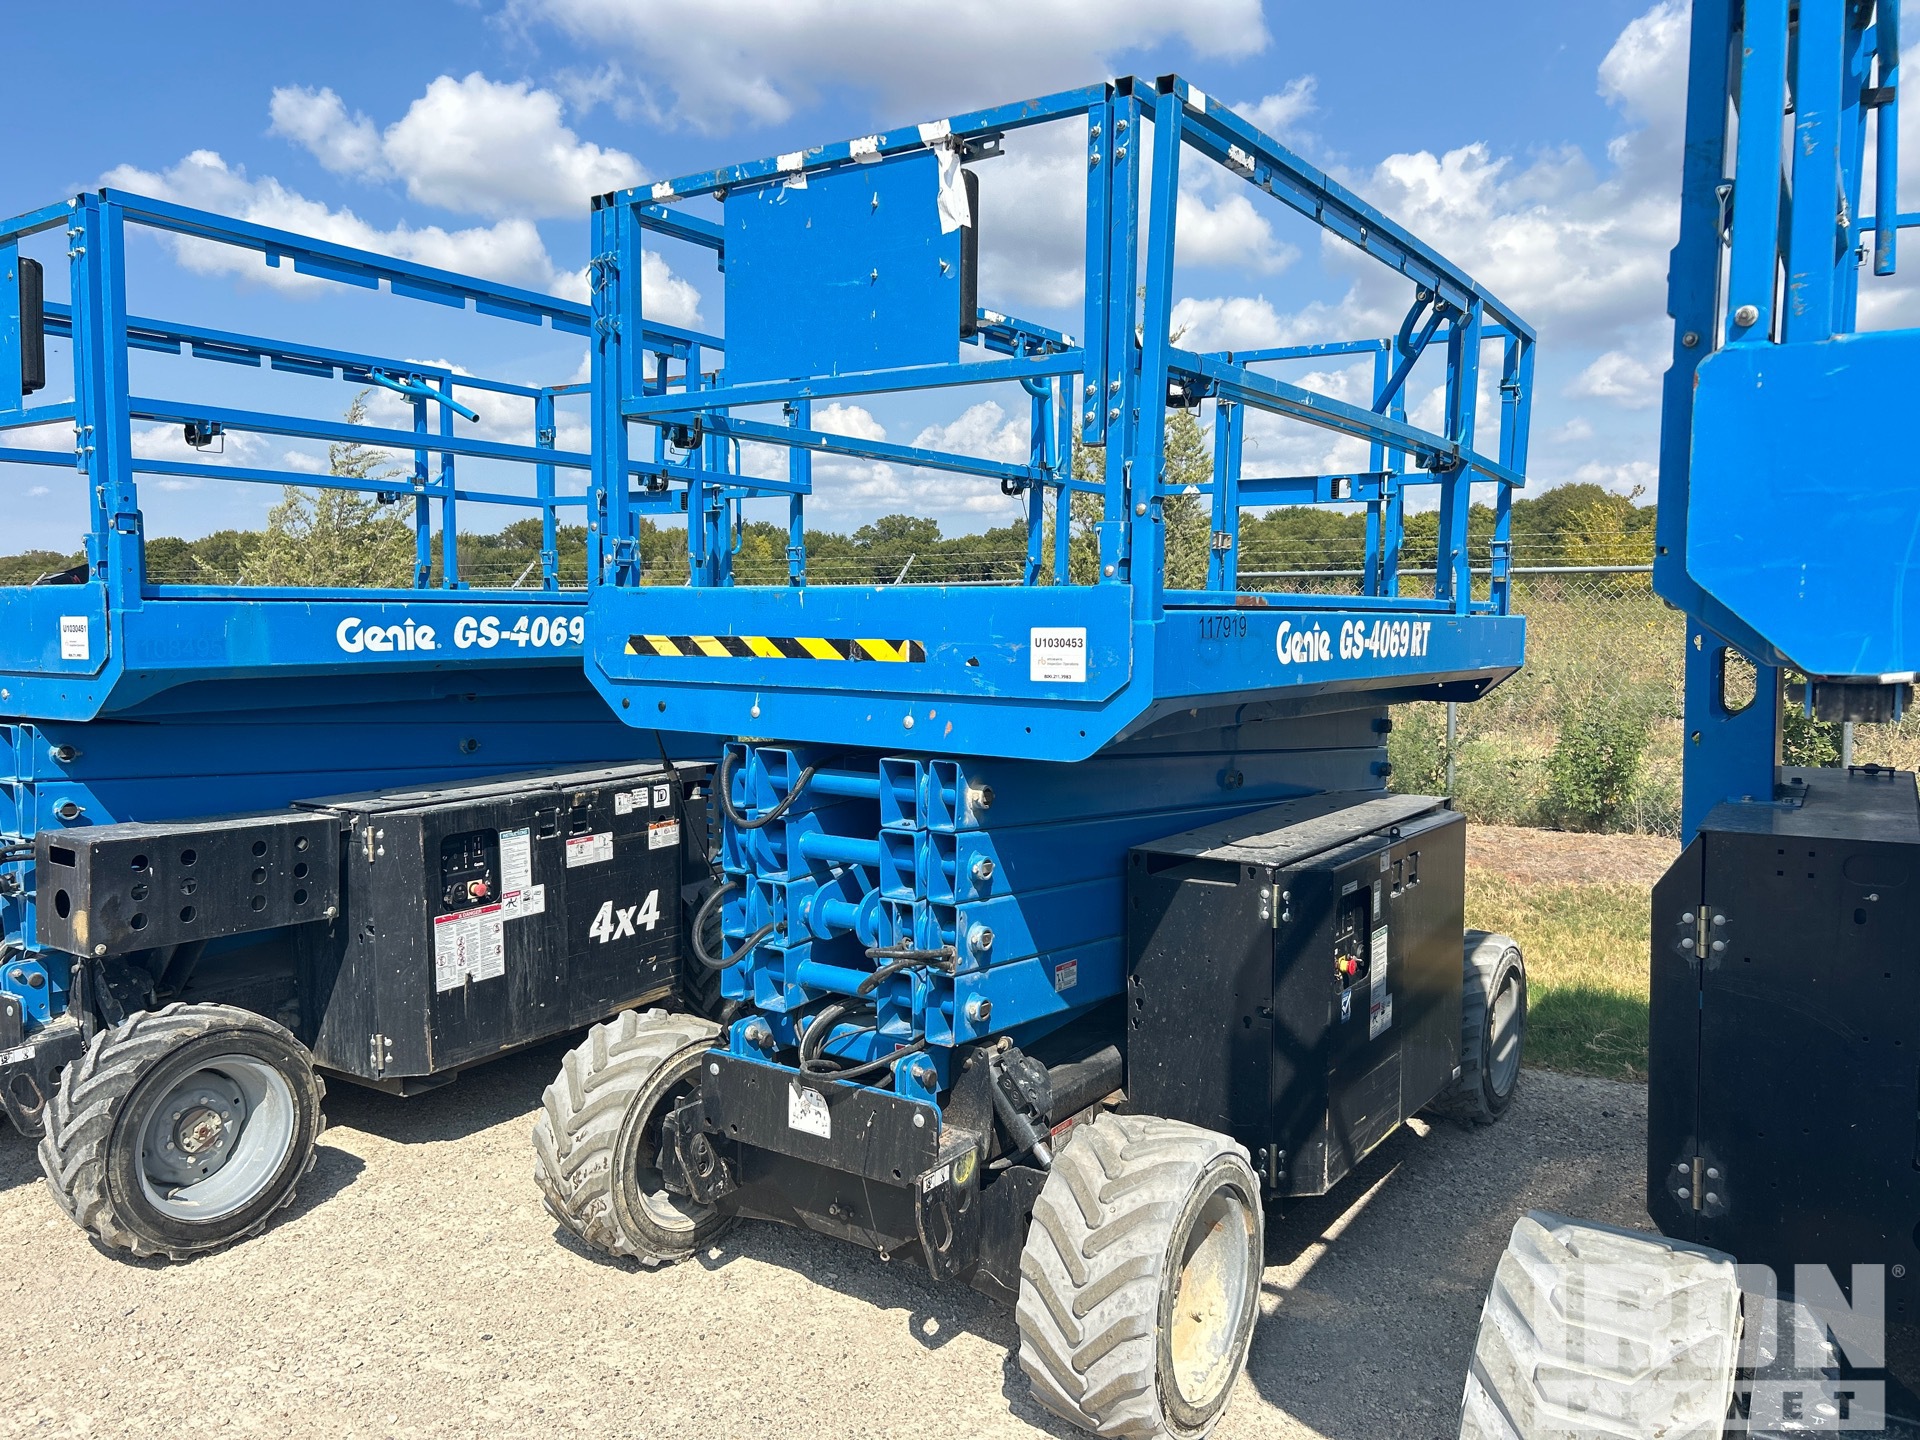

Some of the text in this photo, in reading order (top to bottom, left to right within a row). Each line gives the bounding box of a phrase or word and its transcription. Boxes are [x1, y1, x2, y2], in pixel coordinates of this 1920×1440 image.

[63, 624, 87, 633] U1030451
[336, 617, 436, 654] Genie
[1198, 615, 1248, 639] 117919
[1034, 637, 1084, 648] U1030453
[1276, 620, 1331, 665] Genie
[588, 888, 661, 945] 4x4
